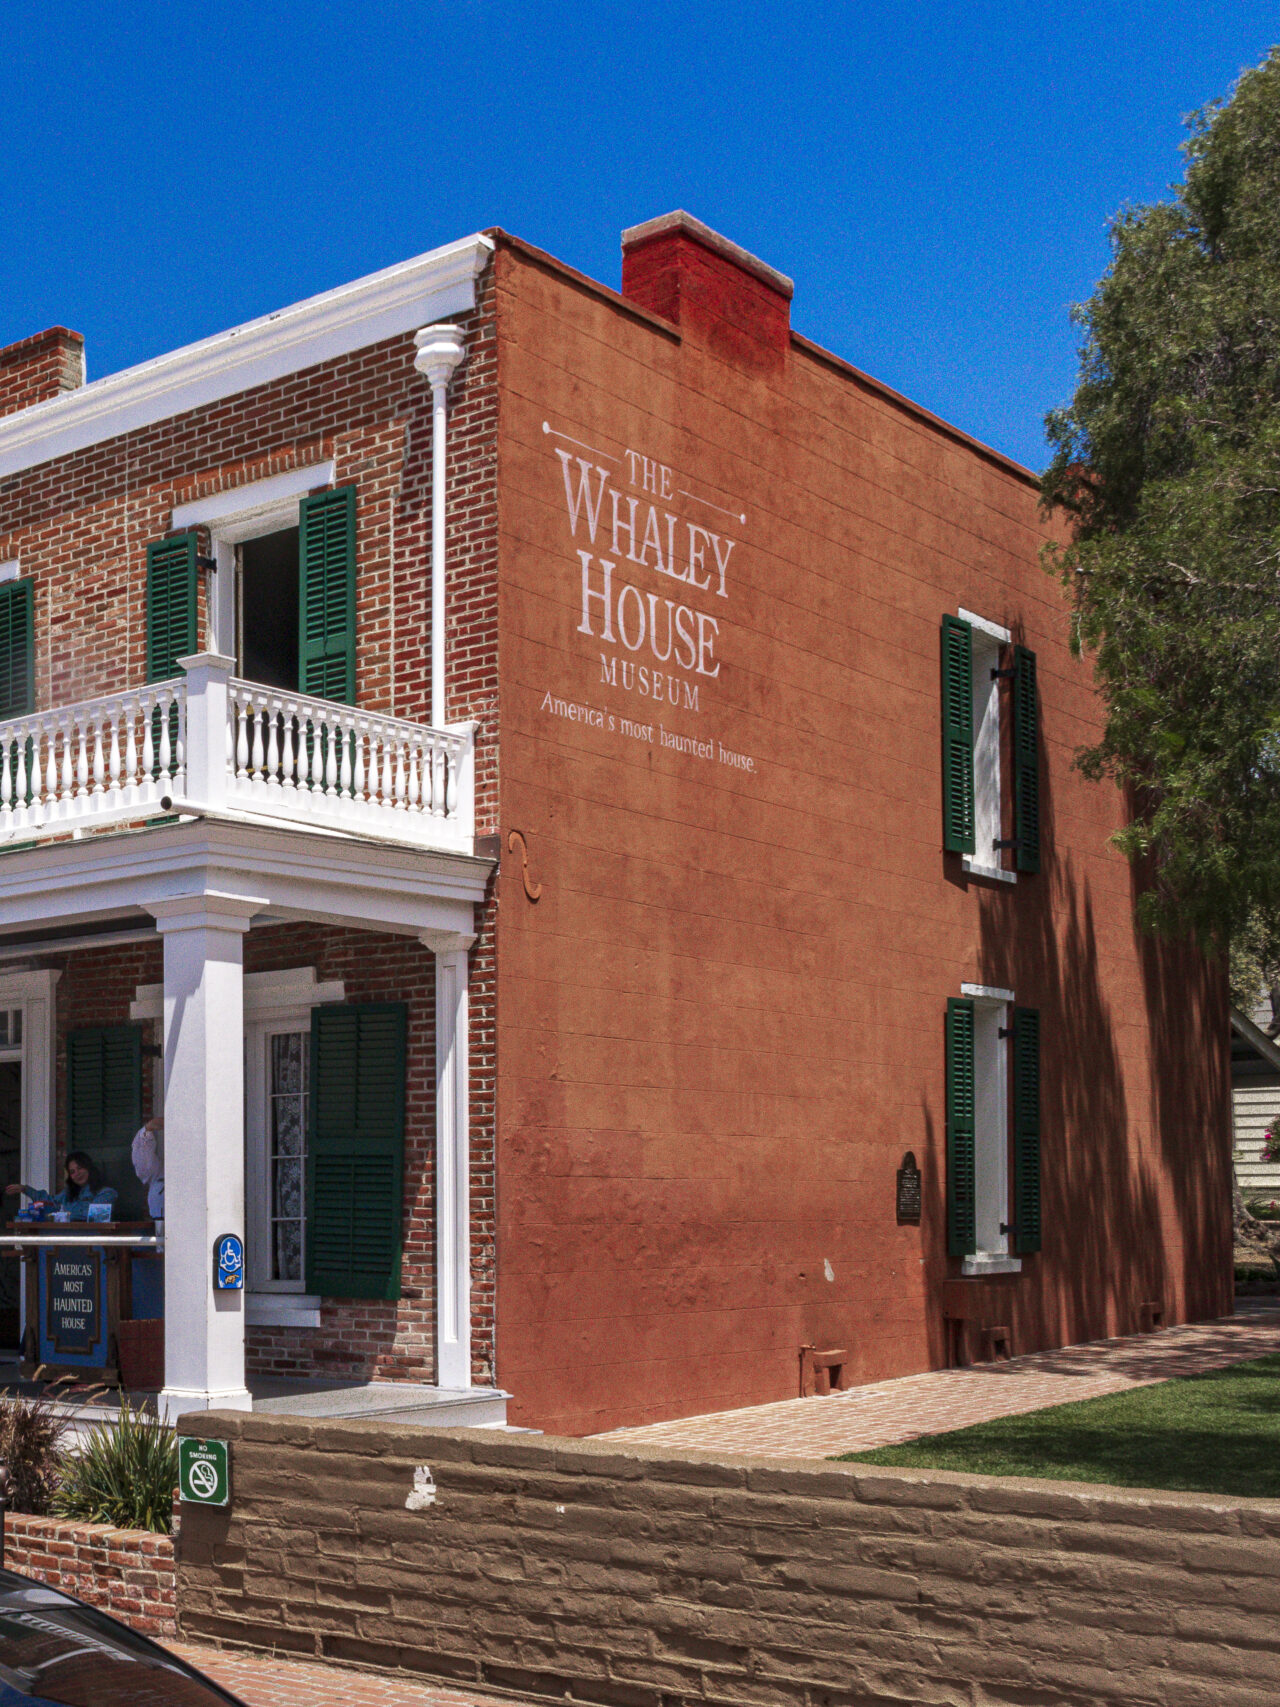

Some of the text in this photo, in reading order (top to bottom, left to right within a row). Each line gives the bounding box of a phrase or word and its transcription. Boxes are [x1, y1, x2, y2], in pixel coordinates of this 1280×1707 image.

[625, 449, 673, 500] THE
[555, 447, 735, 598] WHALEY
[577, 549, 719, 678] HOUSE
[600, 653, 699, 712] MUSEUM
[540, 691, 757, 774] America's most haunted house.
[54, 1262, 92, 1275] AMERICA'S
[63, 1281, 84, 1293] MOST
[53, 1298, 93, 1313] HAUNTED
[61, 1316, 86, 1330] HOUSE
[189, 1452, 216, 1460] SMOKING
